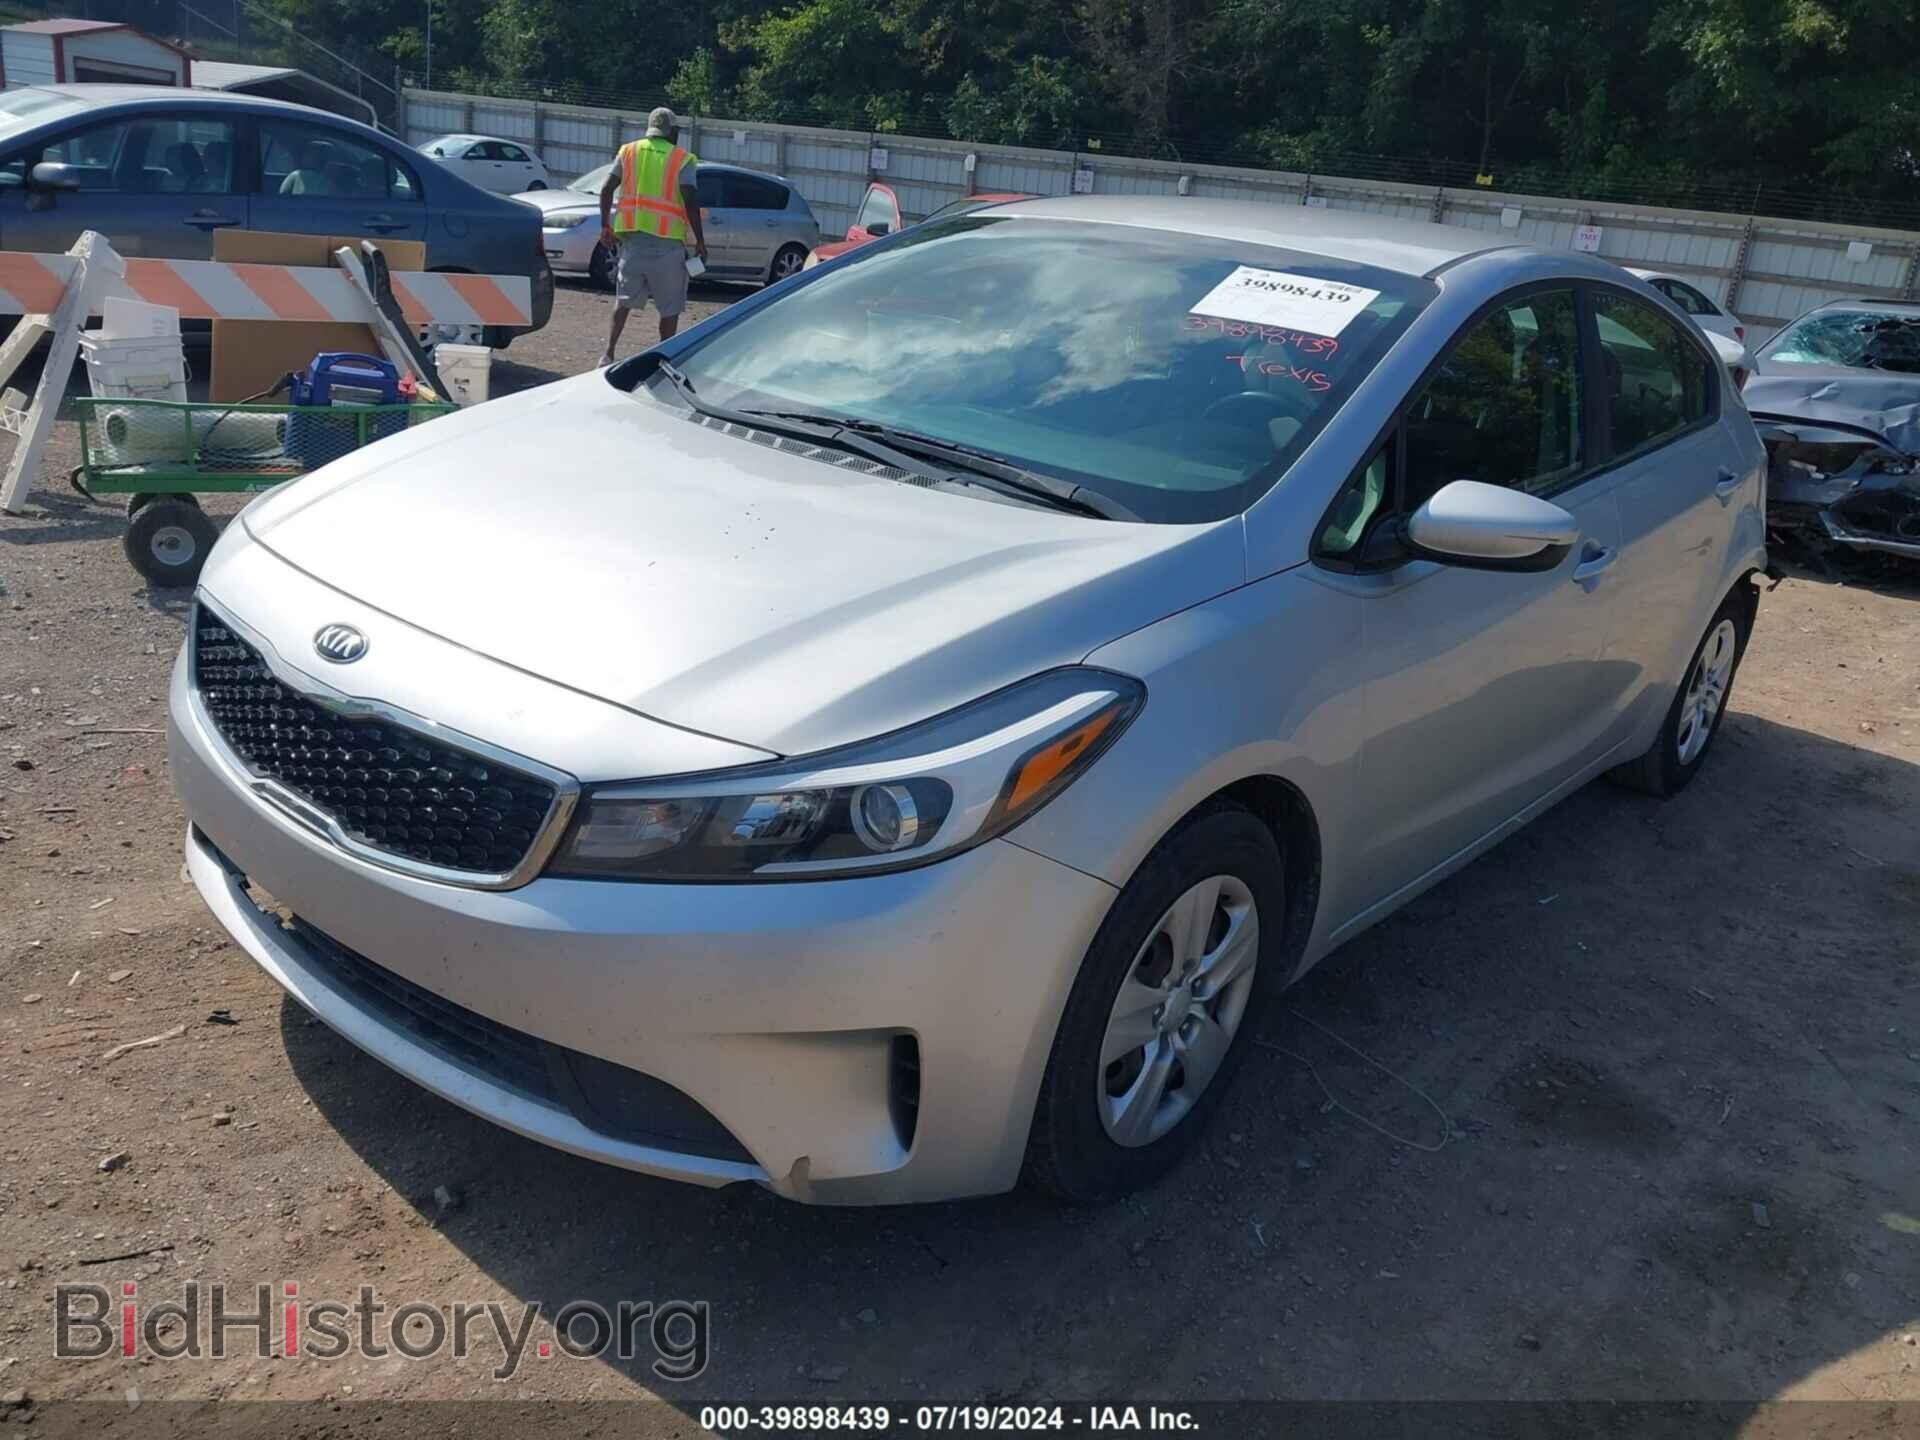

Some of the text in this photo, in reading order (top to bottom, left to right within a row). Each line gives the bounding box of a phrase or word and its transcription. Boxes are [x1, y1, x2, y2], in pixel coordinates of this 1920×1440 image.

[1236, 278, 1352, 304] 39898439
[1184, 315, 1338, 361] 39898439
[316, 625, 362, 658] KIA
